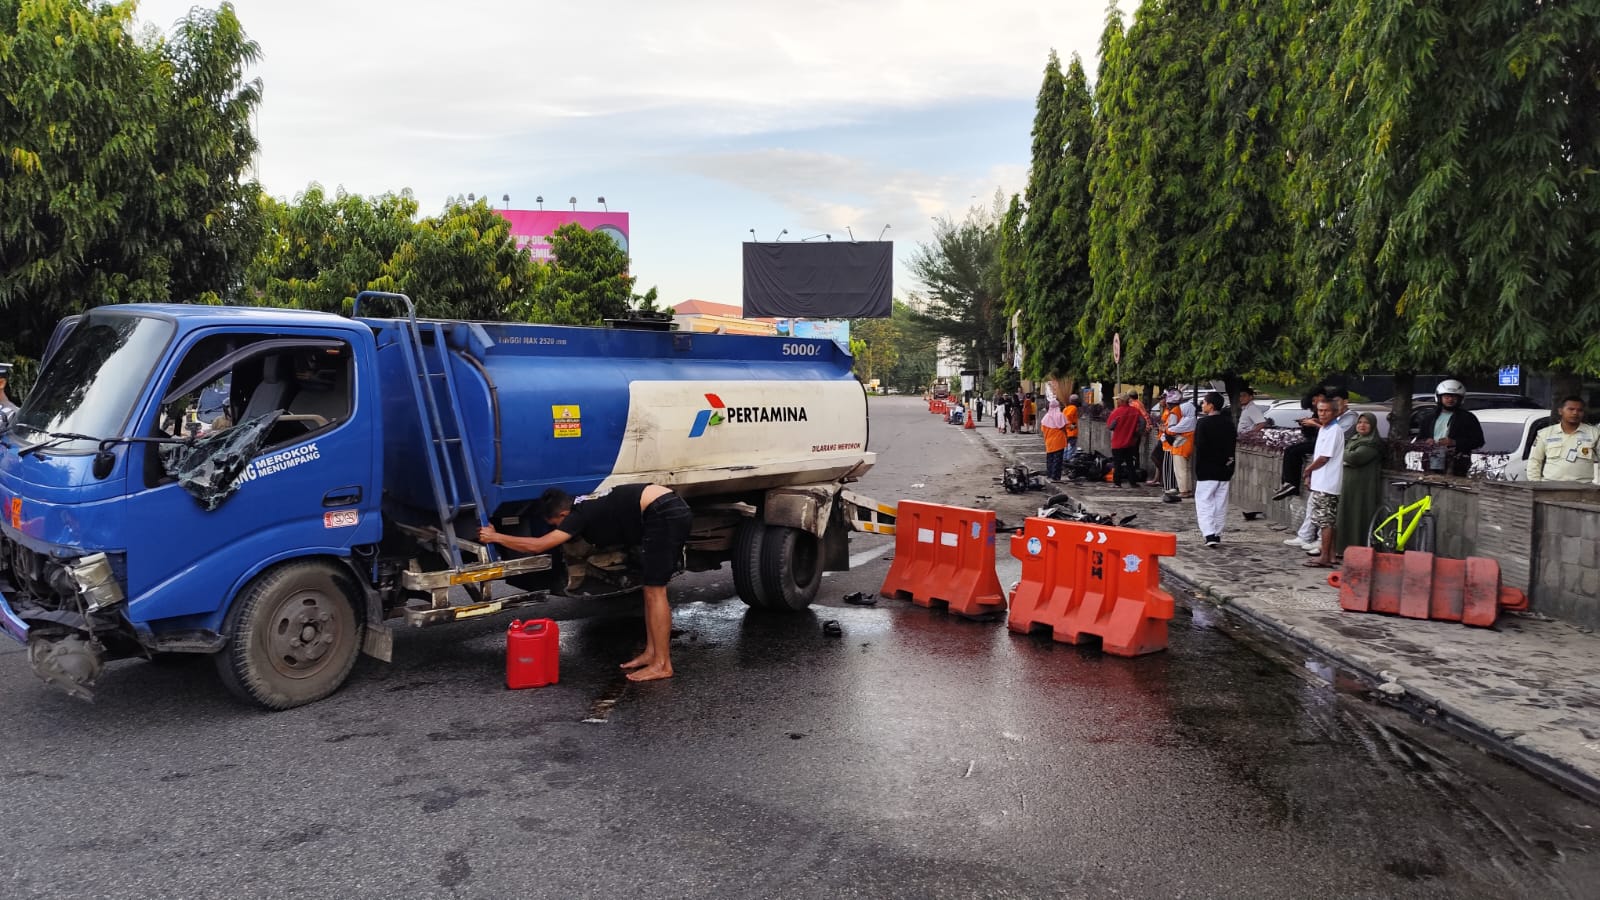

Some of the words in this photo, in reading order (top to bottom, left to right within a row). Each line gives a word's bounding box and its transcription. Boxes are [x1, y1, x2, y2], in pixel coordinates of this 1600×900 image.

[727, 407, 808, 423] PERTAMINA
[255, 443, 318, 469] MEROKOK
[258, 451, 321, 477] MENUMPANG
